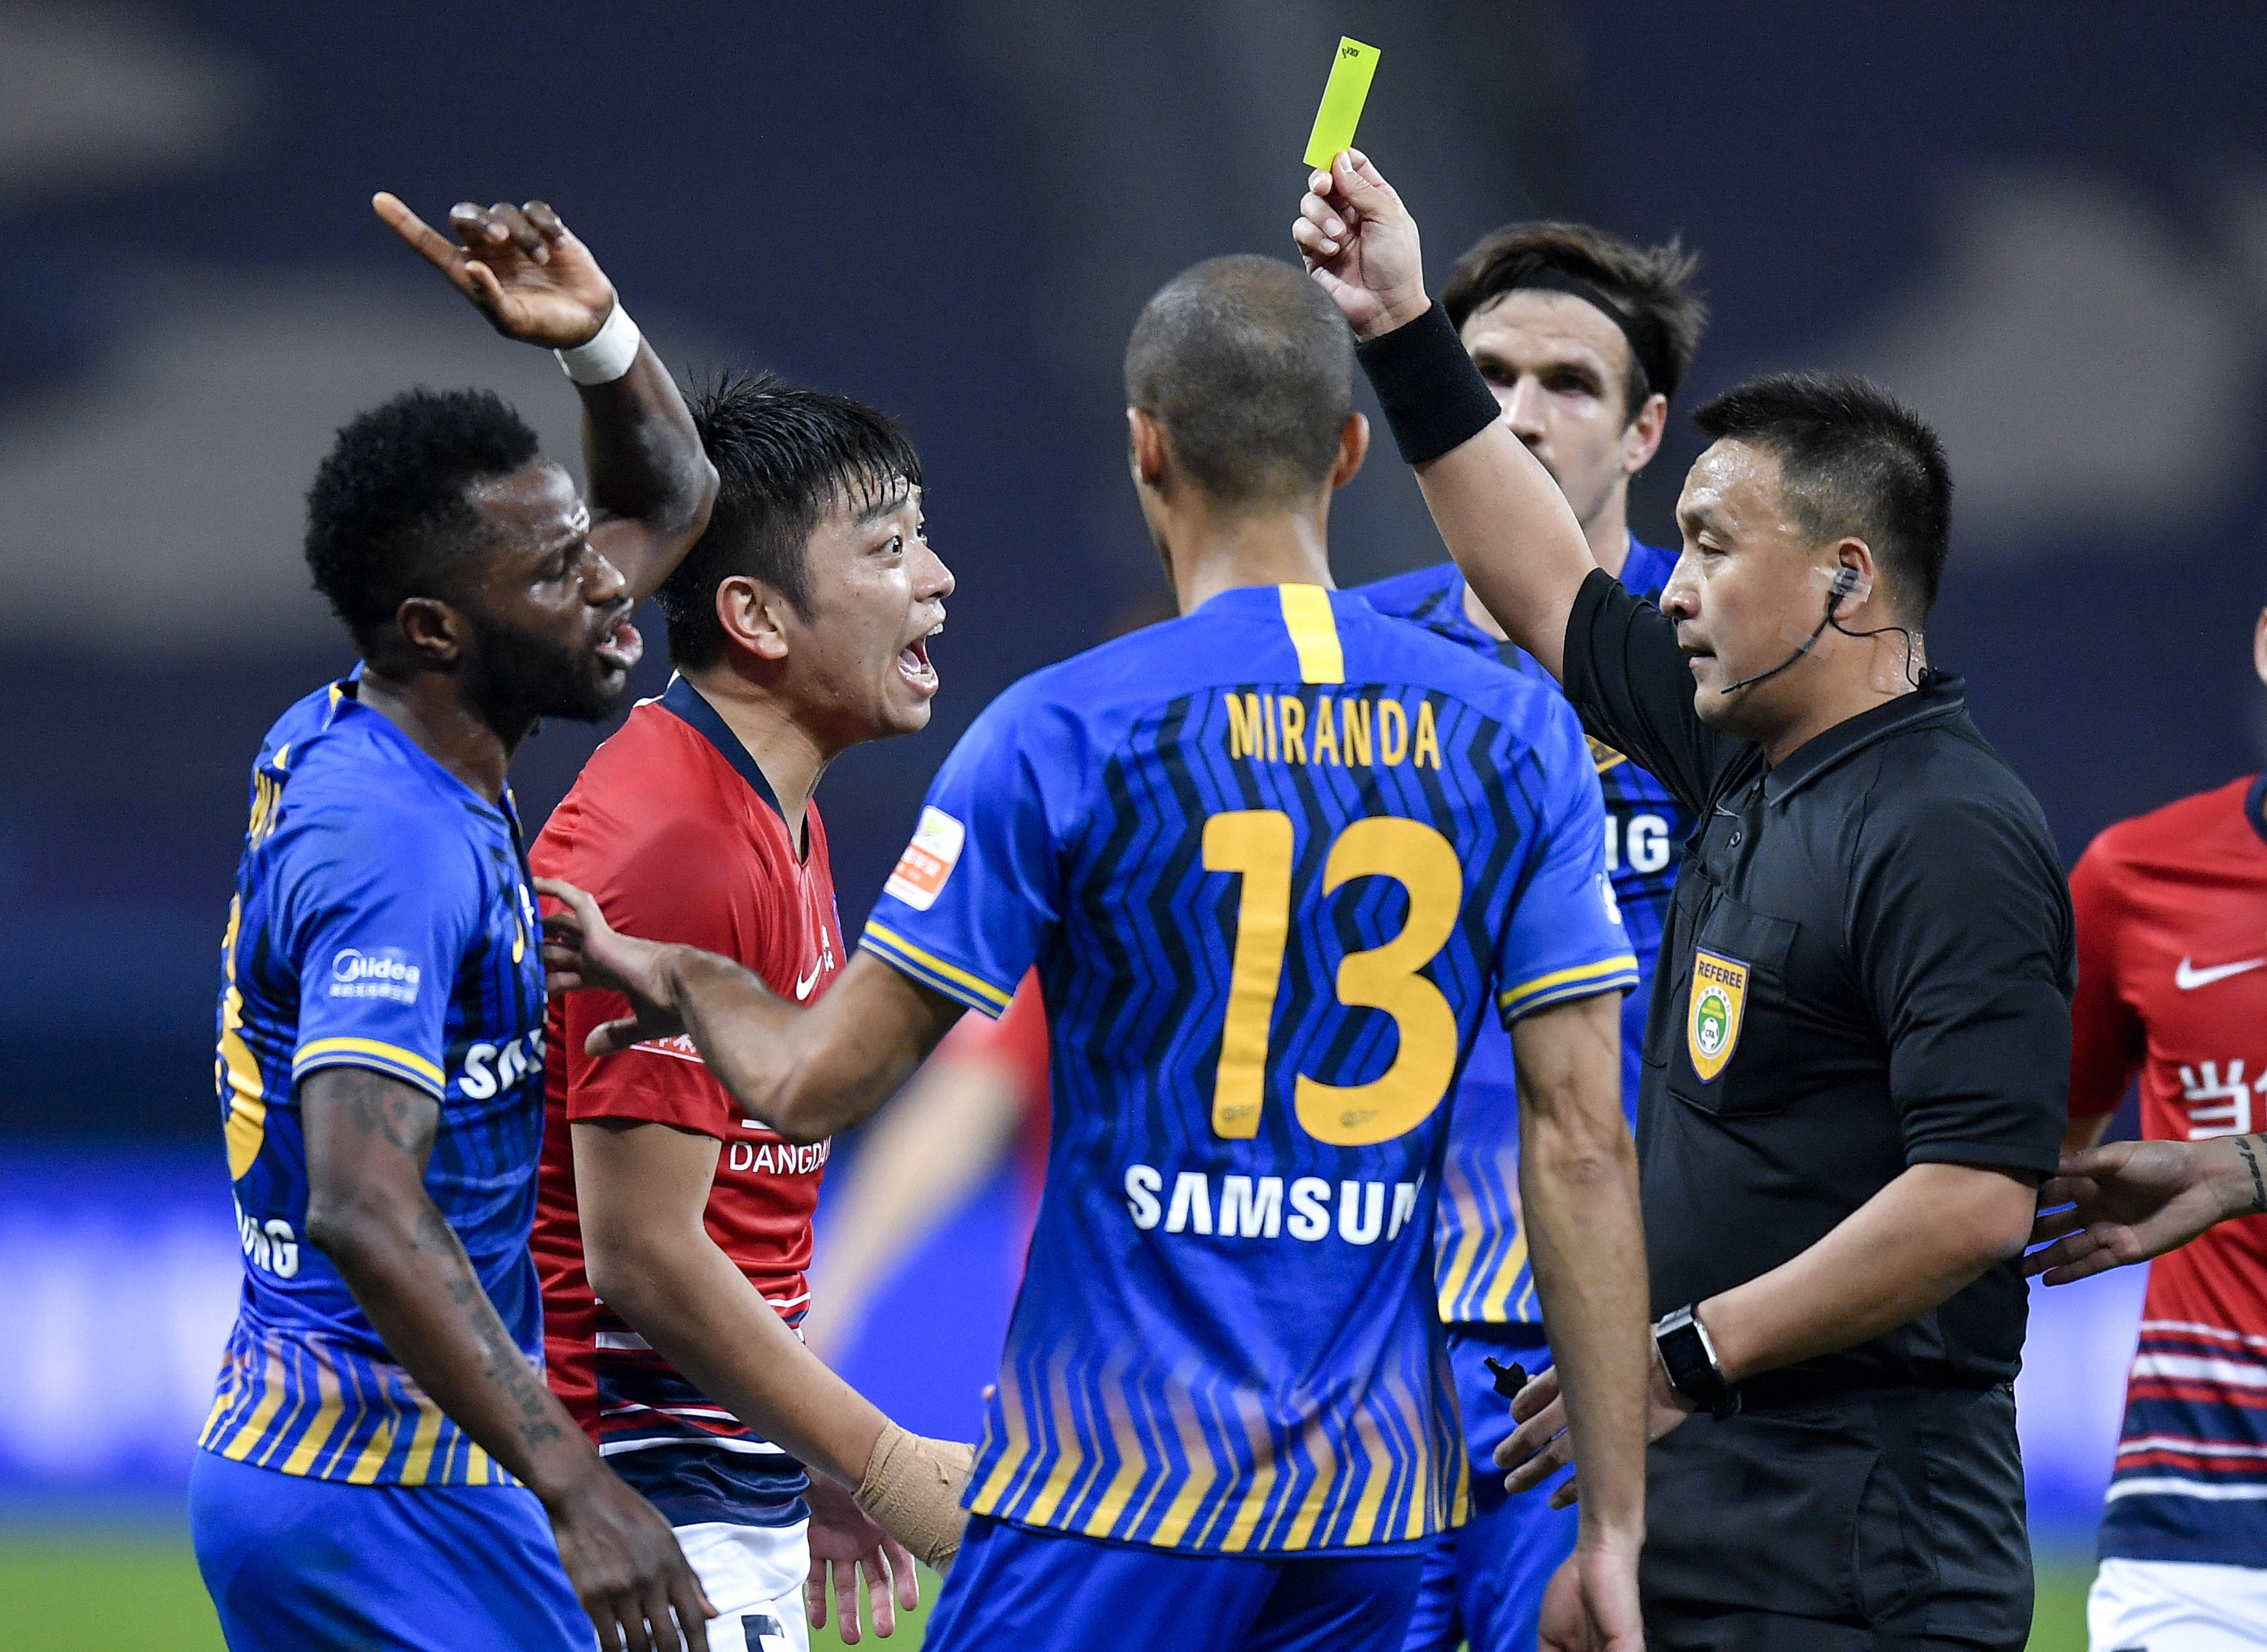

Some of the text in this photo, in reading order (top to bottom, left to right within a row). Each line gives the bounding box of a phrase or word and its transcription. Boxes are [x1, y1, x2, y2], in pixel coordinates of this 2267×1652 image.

[1224, 692, 1442, 771] MIRANDA
[332, 948, 421, 985] Midea
[1201, 809, 1464, 1147] 13
[1698, 960, 1743, 990] REFEREE
[1124, 1164, 1427, 1246] SAMSUN
